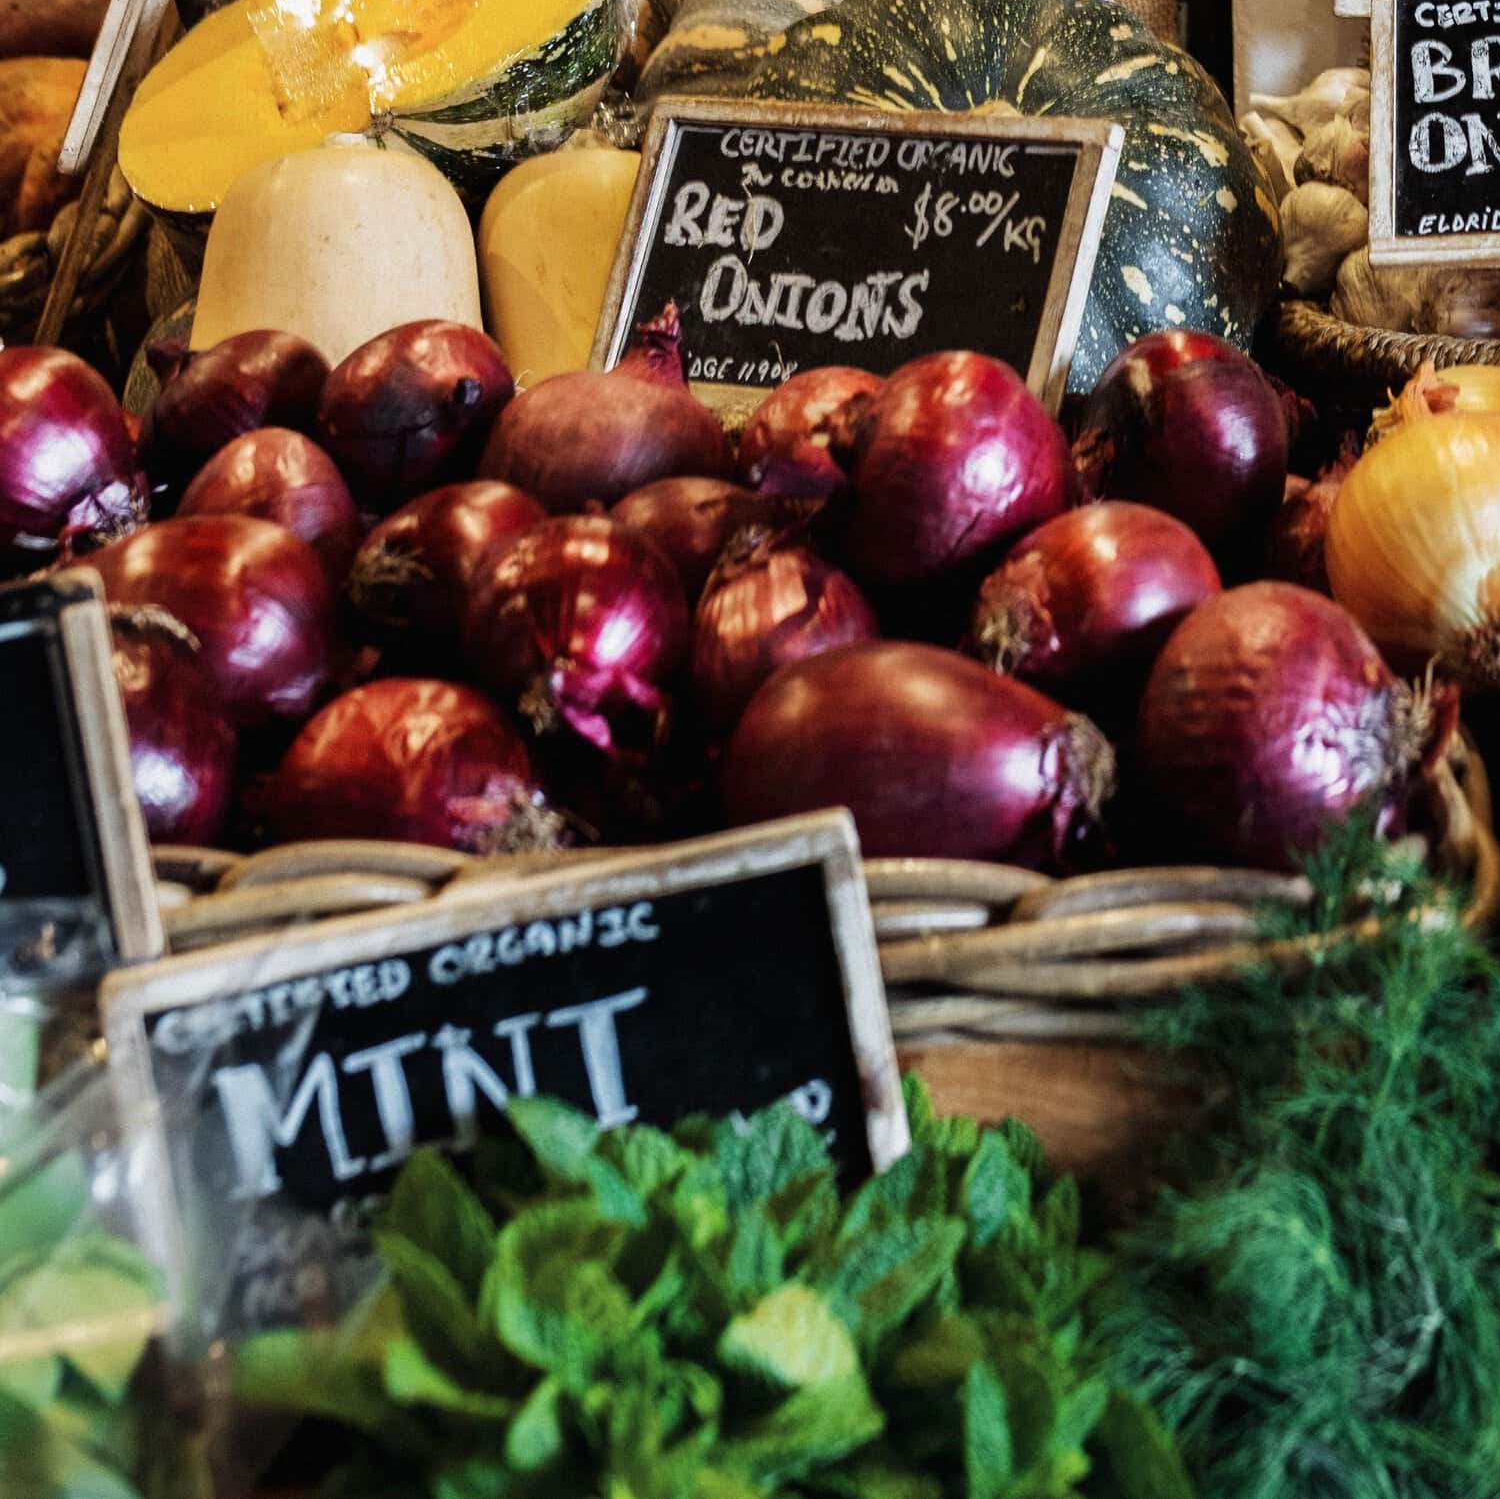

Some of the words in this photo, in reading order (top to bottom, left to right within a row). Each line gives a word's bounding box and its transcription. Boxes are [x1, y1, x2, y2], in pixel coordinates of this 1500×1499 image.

[720, 128, 890, 168] CERTIFIED
[897, 139, 1019, 177] ORGANIC
[664, 181, 785, 251] RED
[429, 903, 660, 986] ORGANIC
[212, 988, 649, 1199] MINT
